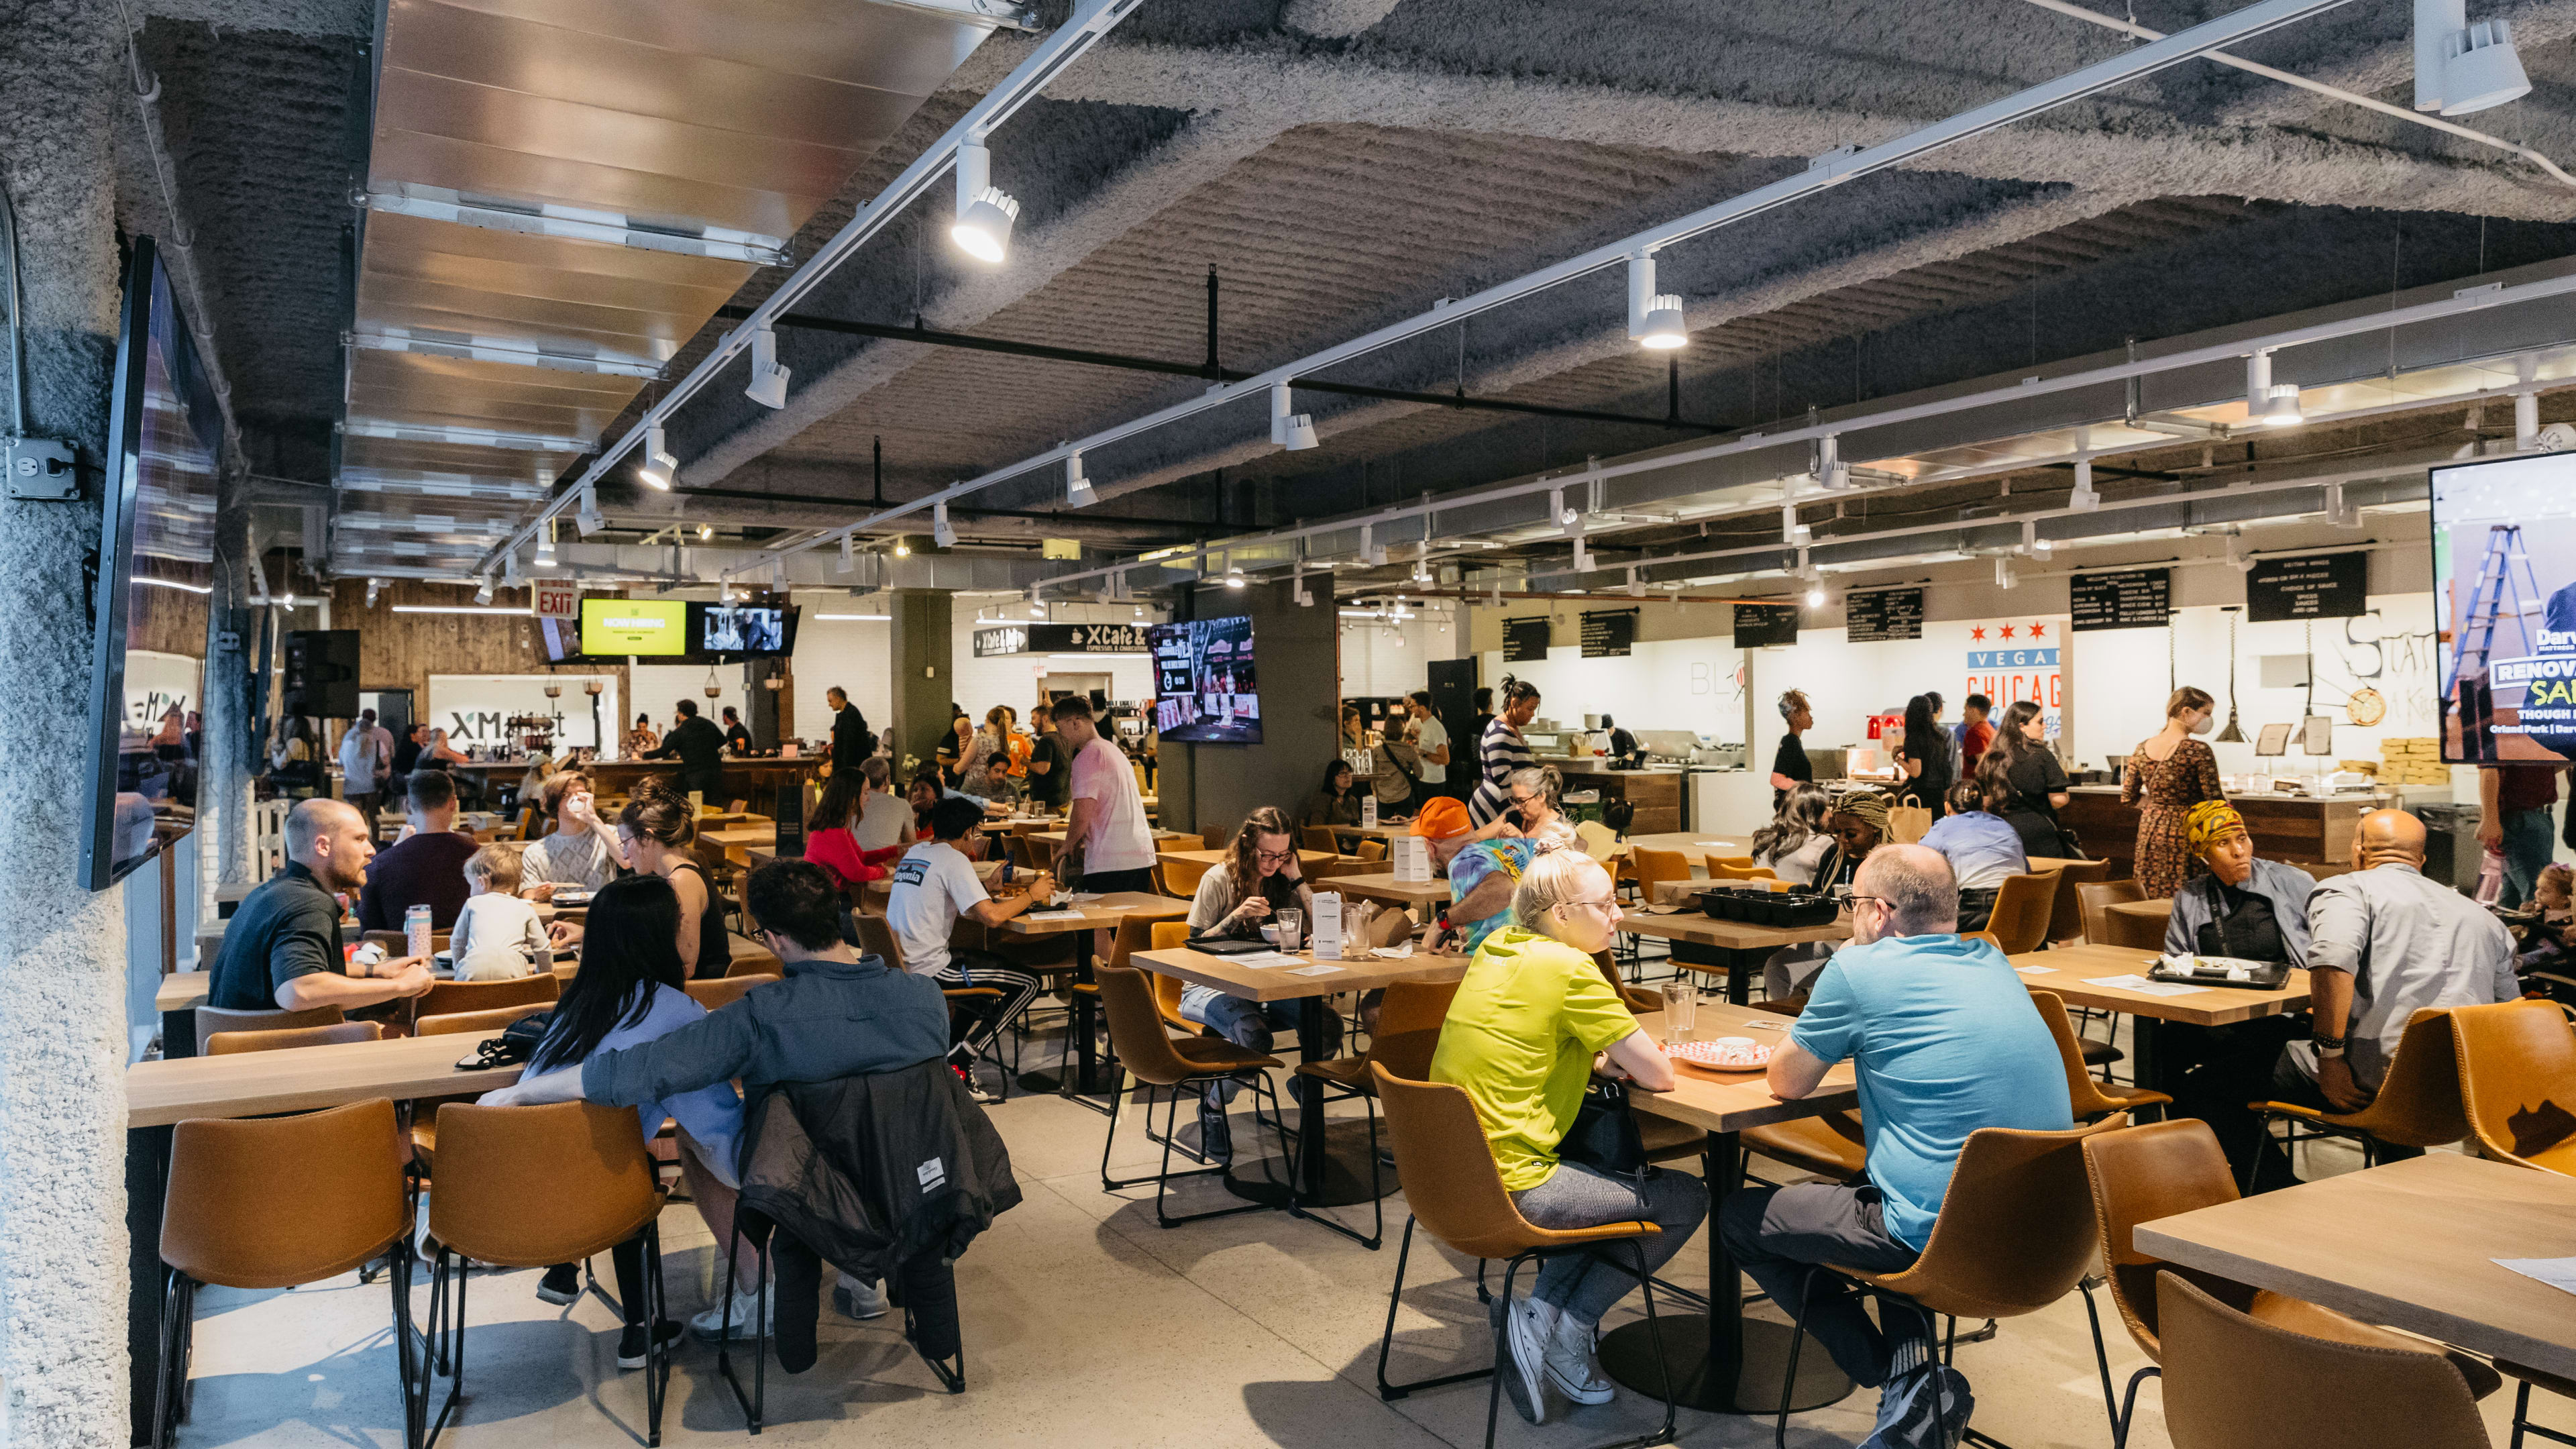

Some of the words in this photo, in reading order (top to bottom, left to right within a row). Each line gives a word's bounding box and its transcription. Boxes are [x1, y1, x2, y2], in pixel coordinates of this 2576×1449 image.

[540, 592, 574, 614] EXIT
[1134, 627, 1146, 645] &
[2498, 660, 2576, 681] RENOV
[2517, 709, 2571, 720] THOUGH
[2489, 724, 2524, 734] Orland
[2525, 724, 2549, 734] Park
